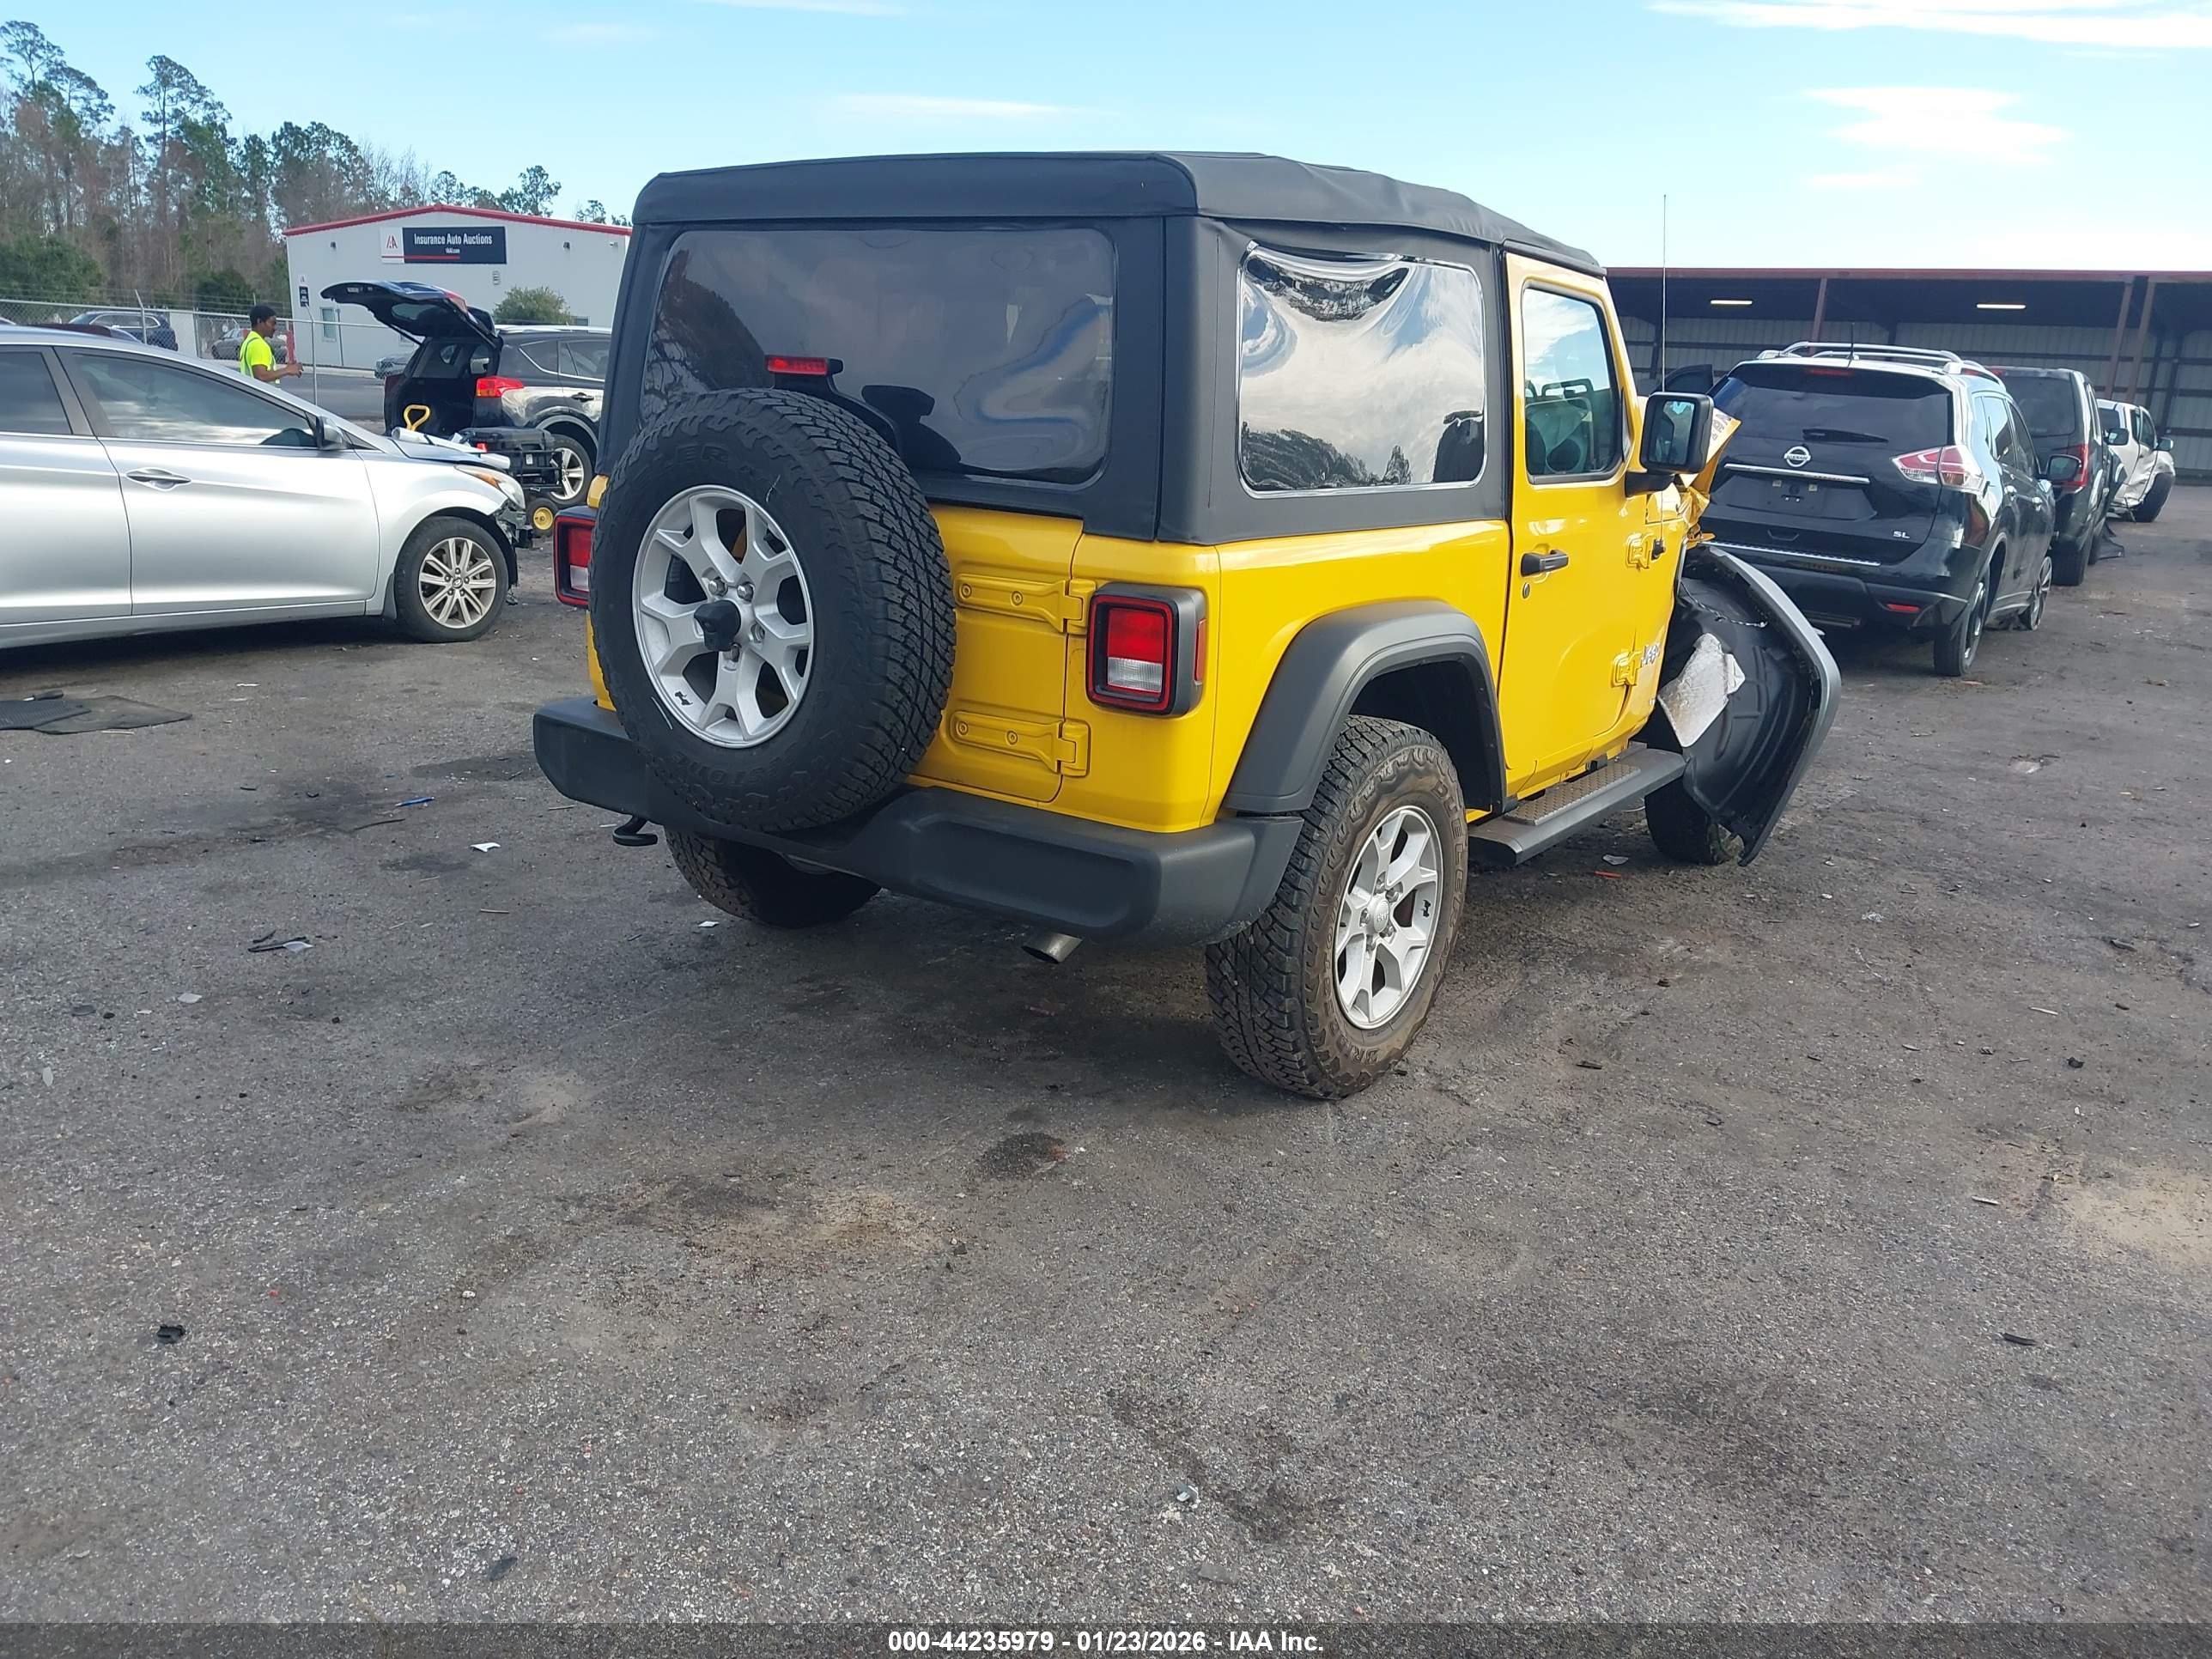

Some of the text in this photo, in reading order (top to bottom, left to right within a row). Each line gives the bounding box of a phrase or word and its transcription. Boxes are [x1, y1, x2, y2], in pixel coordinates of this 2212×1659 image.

[414, 233, 493, 245] Insurance Auto Auctions
[1893, 531, 1911, 539] SL
